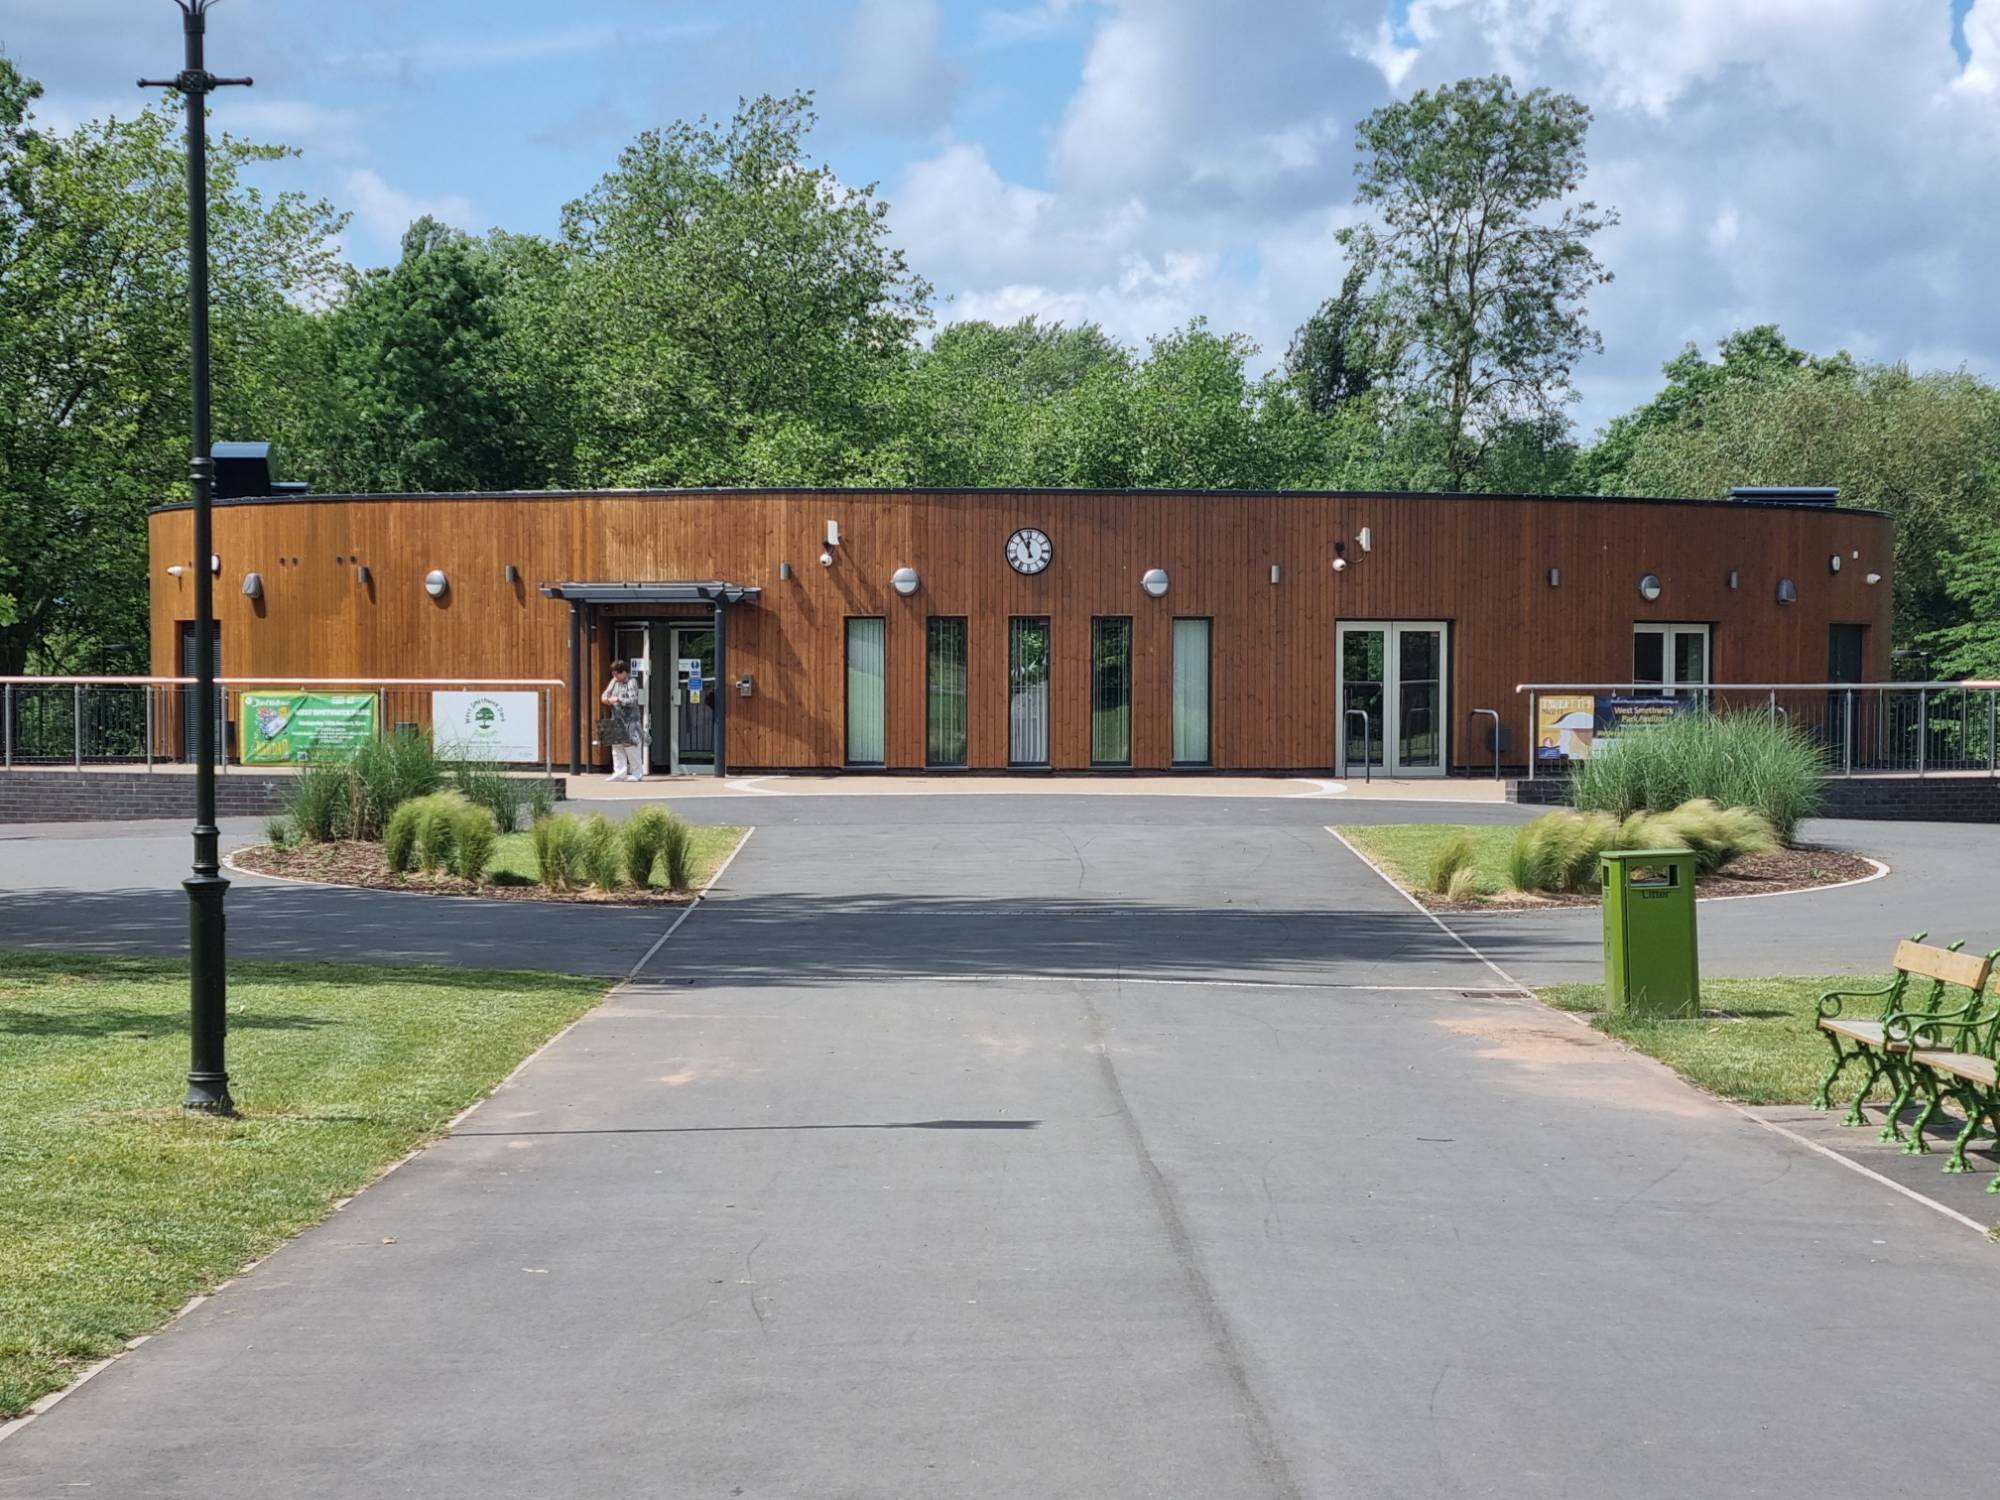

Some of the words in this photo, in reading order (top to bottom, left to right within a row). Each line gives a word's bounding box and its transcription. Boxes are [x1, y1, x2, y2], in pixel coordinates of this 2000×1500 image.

[1614, 705, 1633, 715] West
[1633, 705, 1673, 715] Smethwick
[1642, 889, 1669, 900] Litter
